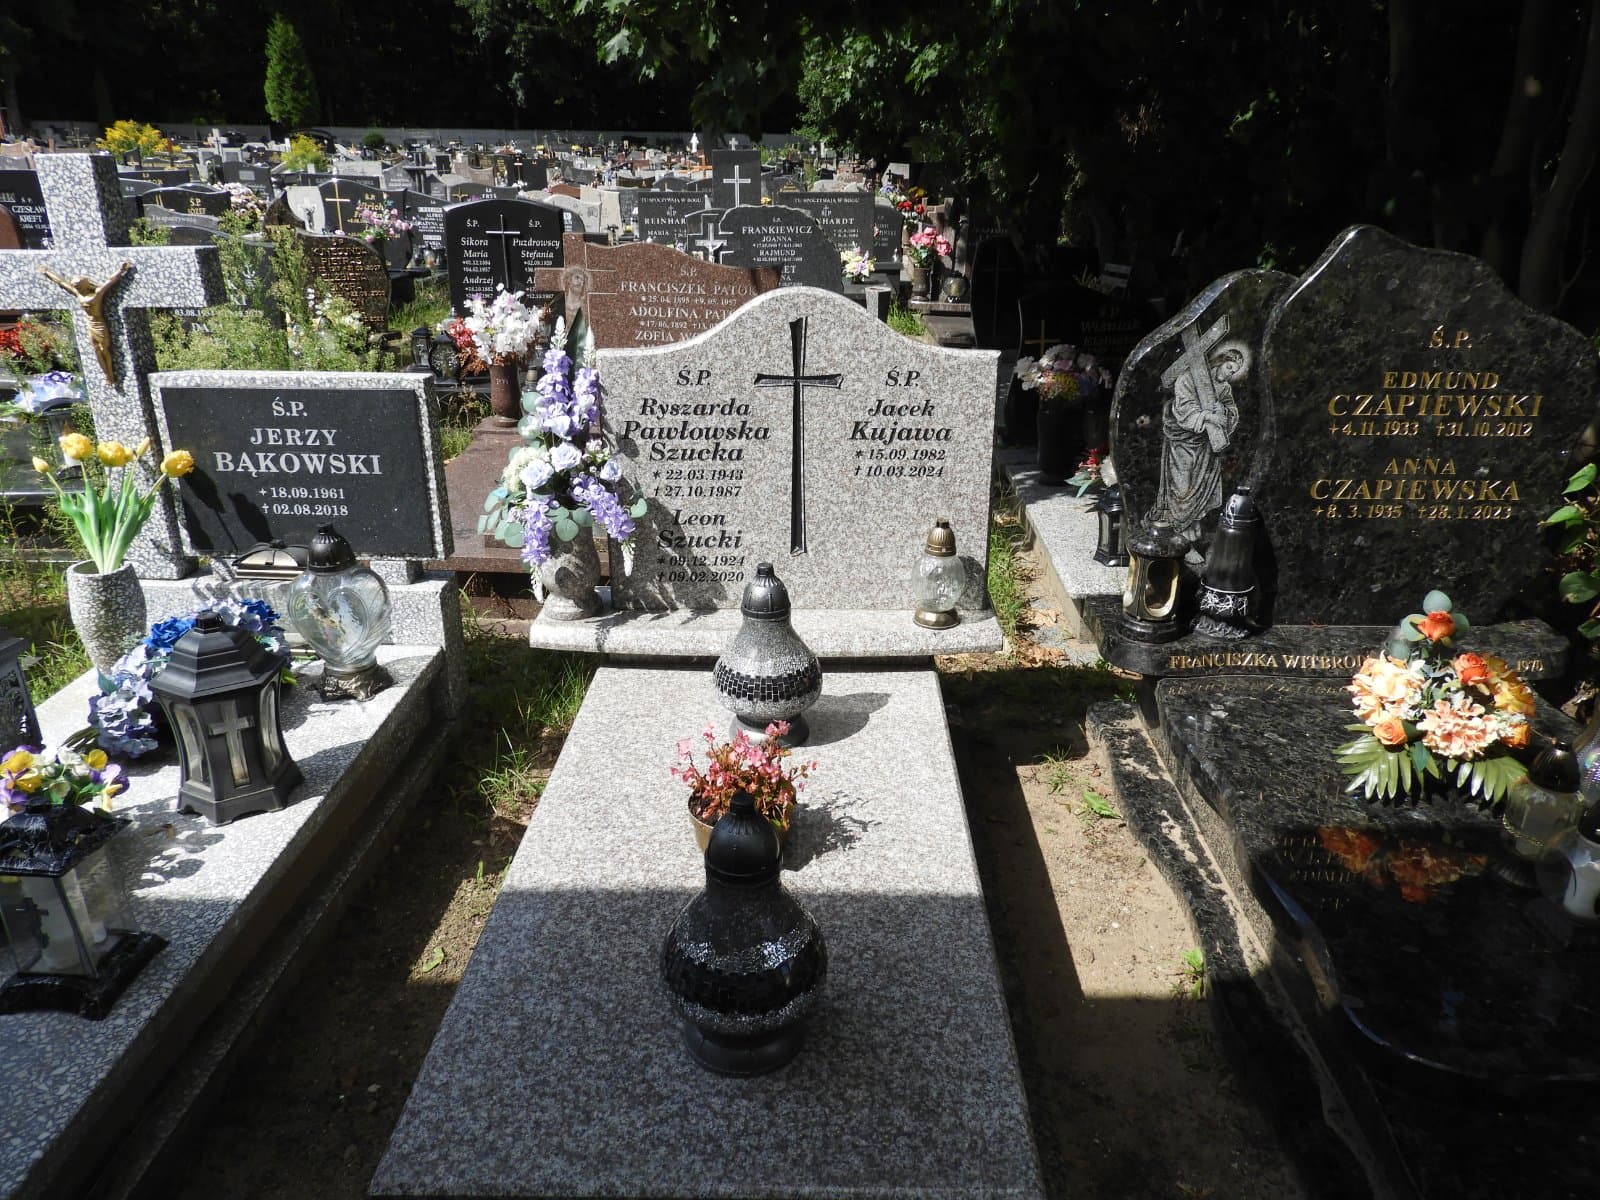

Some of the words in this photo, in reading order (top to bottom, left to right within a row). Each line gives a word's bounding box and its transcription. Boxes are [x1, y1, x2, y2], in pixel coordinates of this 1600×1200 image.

[644, 217, 686, 225] REINHAR
[815, 217, 855, 225] NHARDT
[742, 226, 813, 235] FRANKIEWICZ
[461, 237, 489, 247] Sikora
[513, 238, 561, 249] Puzdrowscy
[463, 249, 489, 258] Maria
[521, 250, 554, 260] Stefania
[462, 275, 494, 286] Andrzej
[620, 281, 707, 295] FRANCISZEK
[629, 306, 698, 319] ADOLFINA
[635, 330, 675, 342] ZOFIA
[676, 364, 712, 387] Ś.P.
[885, 365, 921, 387] Ś.P.
[1383, 370, 1500, 390] EDMUND
[271, 396, 308, 417] Ś.P.
[639, 398, 752, 420] Ryszarda
[867, 399, 936, 417] Jacek
[1327, 394, 1544, 417] CZAPIEWSKI
[250, 427, 337, 446] JERZY
[621, 420, 771, 441] Pawłowska
[848, 420, 953, 446] Kujawa
[649, 441, 745, 462] Szucka
[213, 451, 384, 478] BĄKOWSKI
[1384, 458, 1457, 475] ANNA
[1309, 478, 1521, 501] CZAPIEWSKA
[671, 509, 728, 527] Leon
[657, 529, 744, 550] Szucki
[1169, 653, 1279, 670] FRANCISZKA
